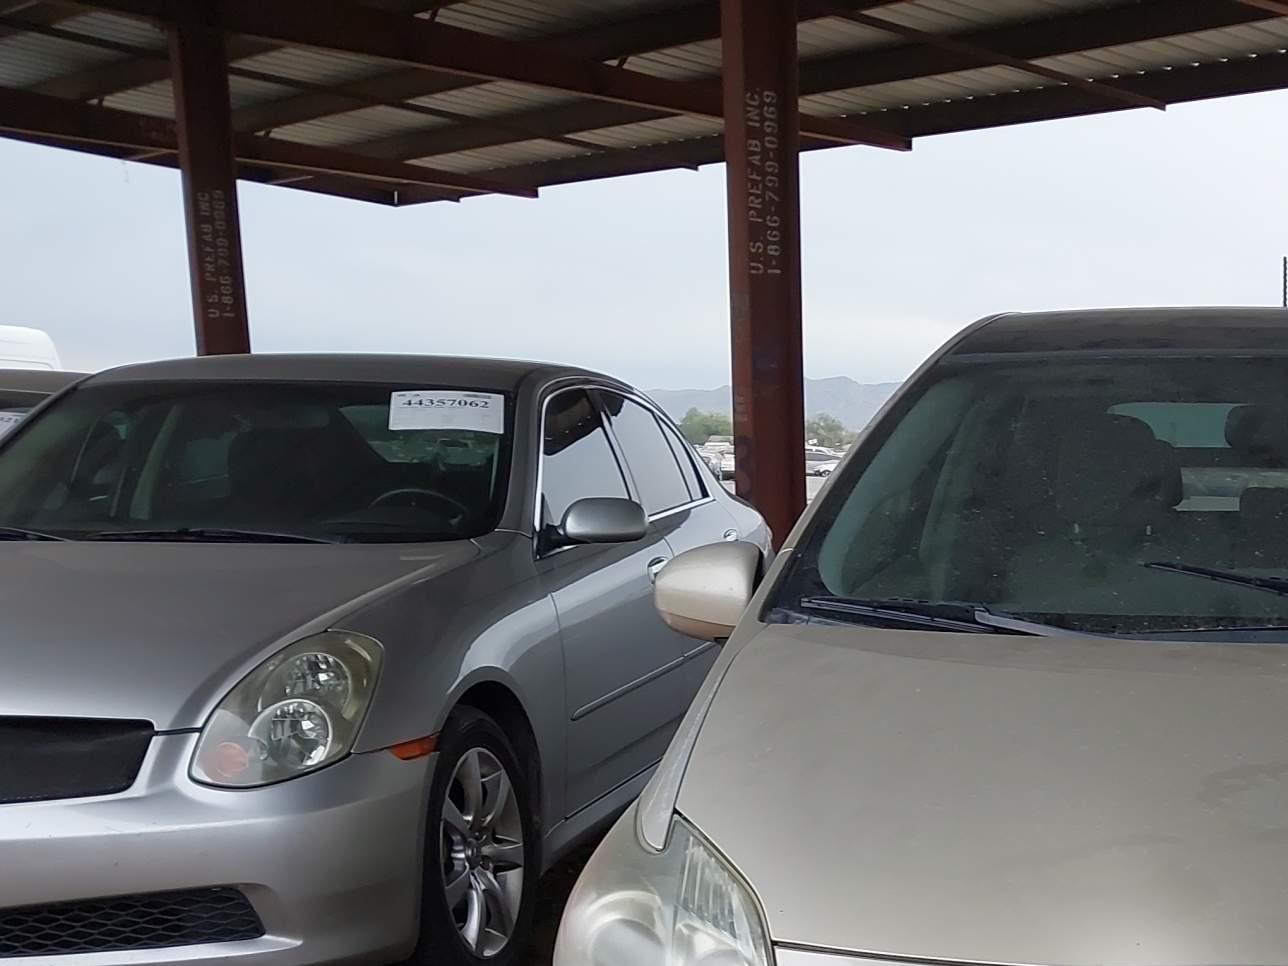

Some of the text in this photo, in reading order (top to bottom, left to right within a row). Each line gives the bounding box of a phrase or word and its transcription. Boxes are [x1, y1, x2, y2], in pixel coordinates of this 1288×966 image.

[746, 88, 764, 275] U.S. PREFAB INC.
[763, 91, 782, 275] 1-866-799-0969
[402, 399, 489, 409] 44357062
